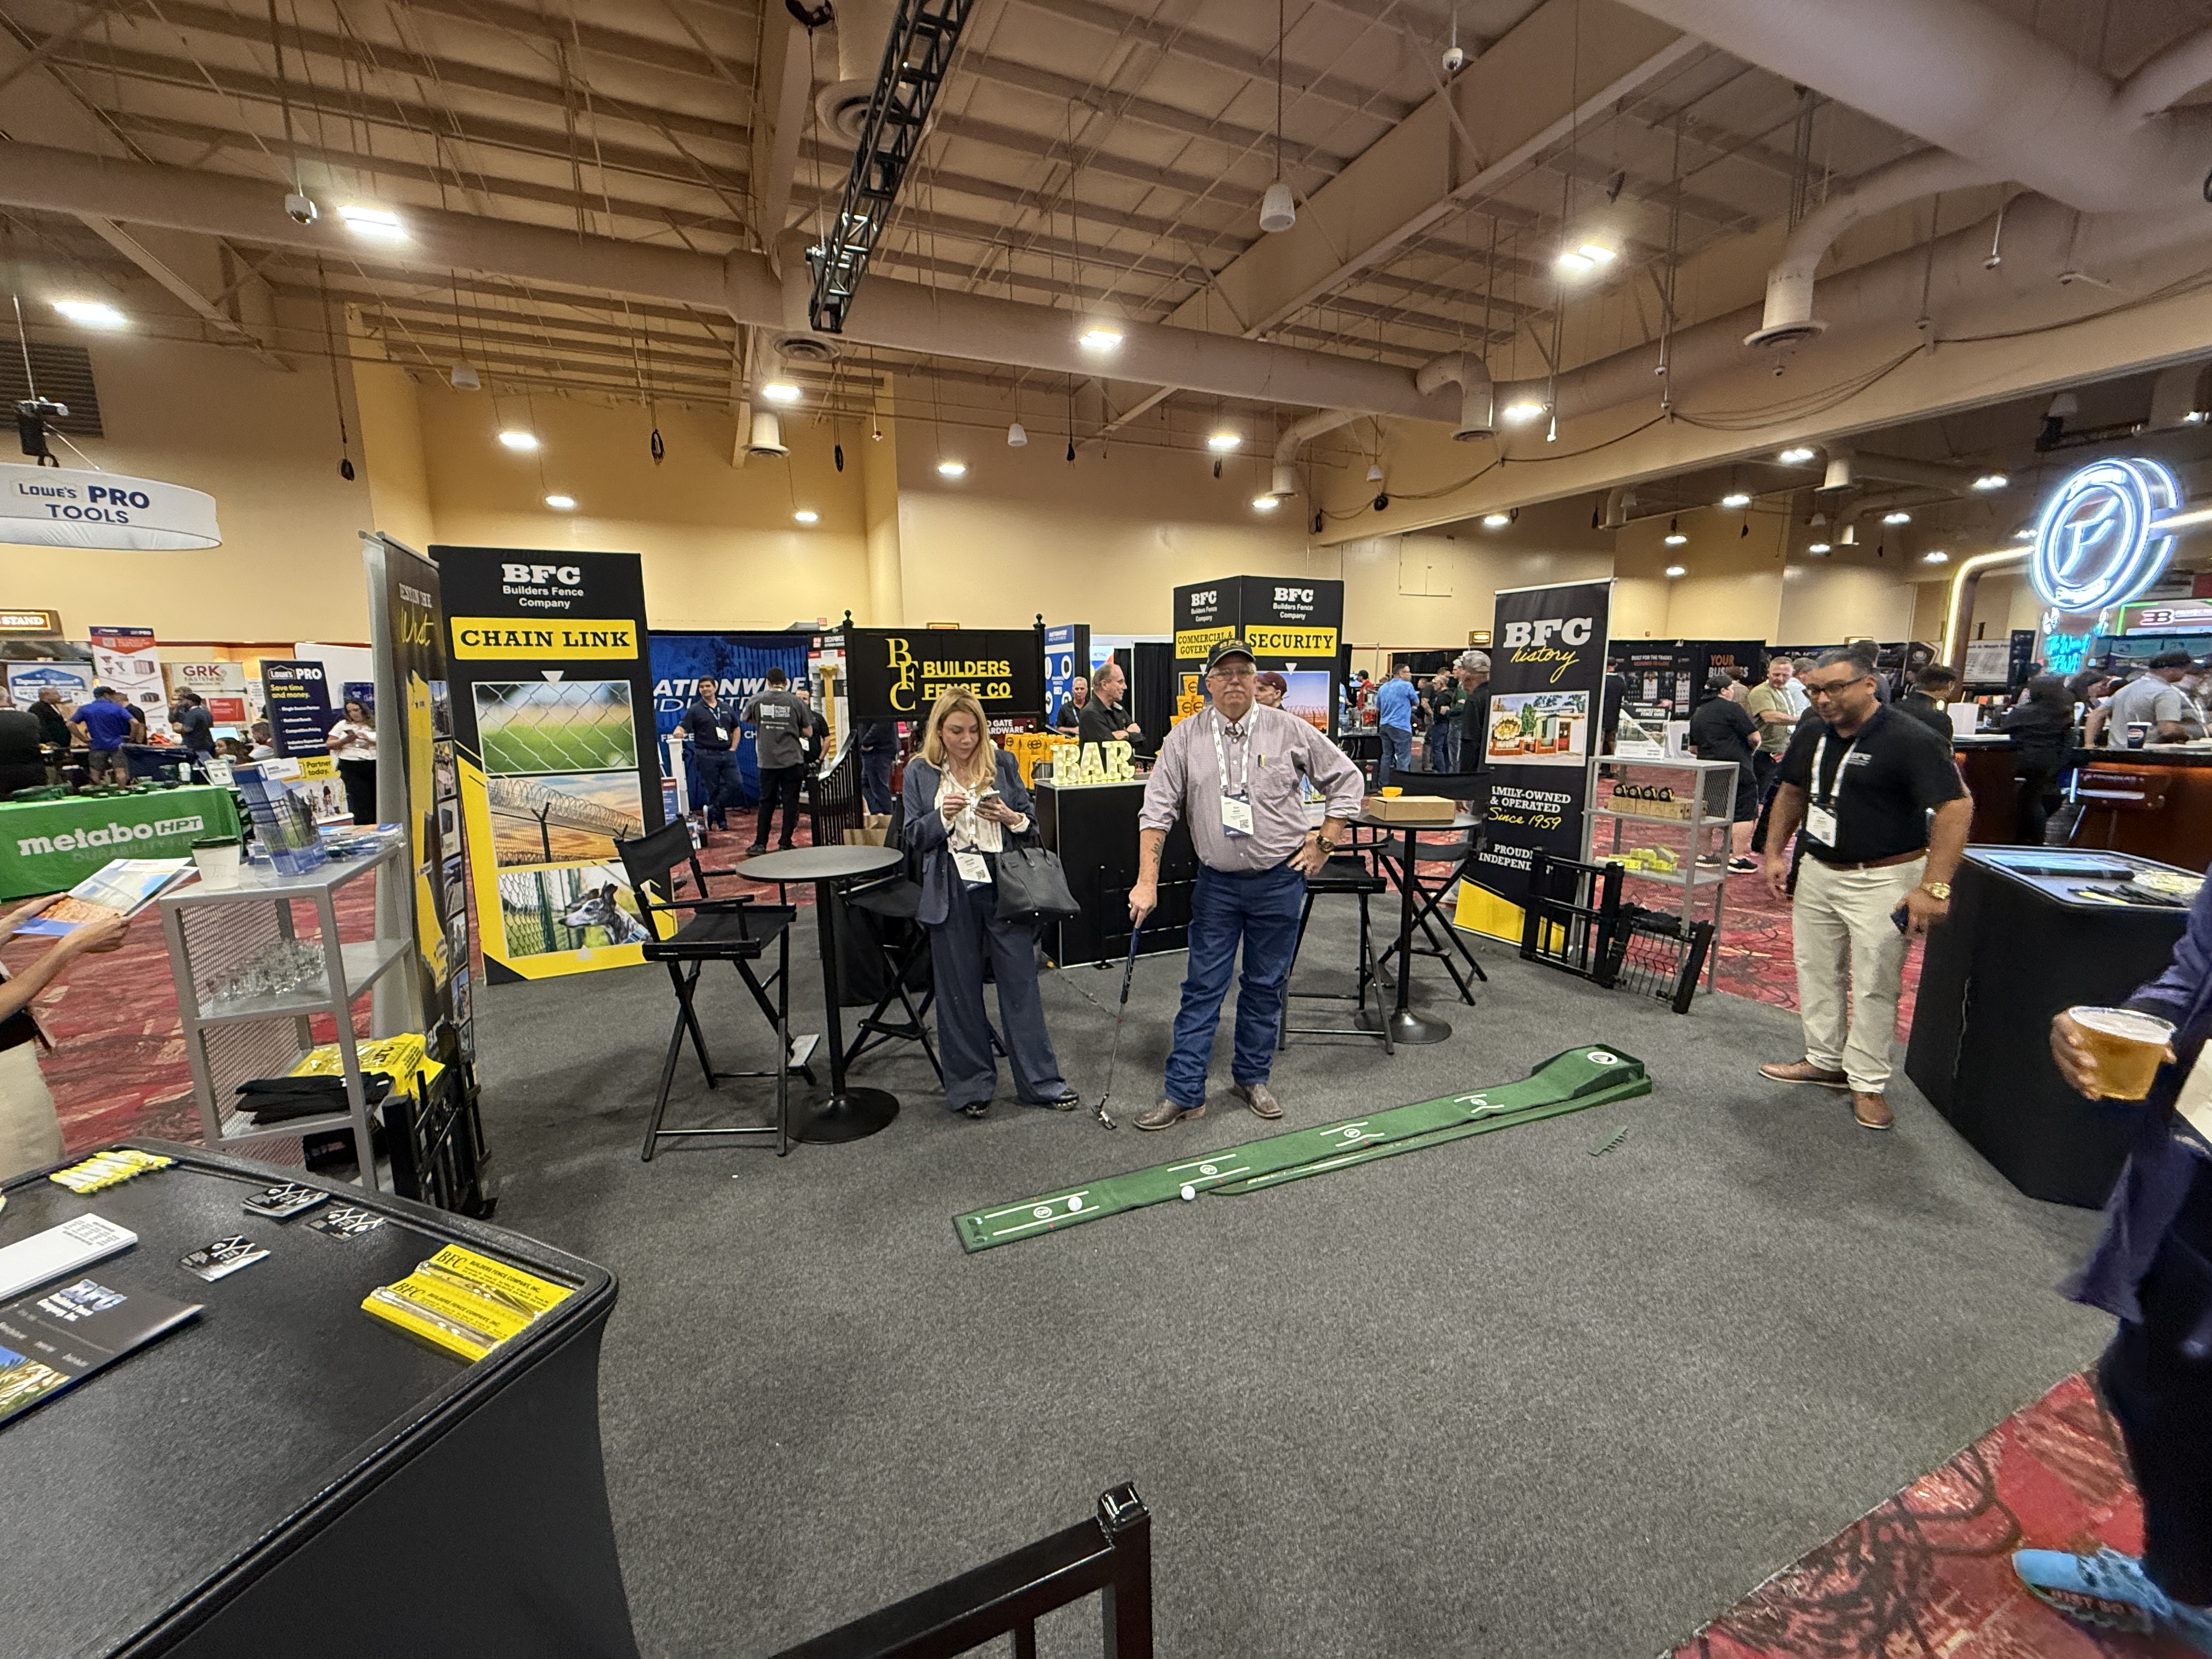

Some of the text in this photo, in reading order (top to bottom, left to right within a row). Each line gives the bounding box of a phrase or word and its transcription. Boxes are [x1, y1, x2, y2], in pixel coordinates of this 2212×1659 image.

[19, 483, 150, 509] LOWE'S PRO
[45, 504, 129, 523] TOOLS
[501, 564, 580, 585] BFC
[503, 585, 584, 596] Builders Fence
[1191, 590, 1217, 607] BFC
[1274, 588, 1313, 602] BFC
[519, 597, 571, 610] Company
[1, 617, 44, 625] STAND
[1280, 611, 1306, 620] Company
[460, 630, 630, 647] CHAIN LINK
[1178, 632, 1224, 645] COMMERCIAL
[1503, 617, 1593, 648] BFC
[1249, 633, 1334, 649] SECURITY
[1510, 644, 1580, 684] history
[1711, 654, 1735, 665] YOUR
[183, 665, 221, 676] GRK
[296, 668, 322, 680] PRO
[923, 661, 1011, 676] BUILDERS
[987, 682, 1011, 697] CO
[987, 726, 1024, 735] ARDWARE
[306, 759, 331, 768] Partner
[1050, 741, 1135, 785] BAR
[1490, 796, 1561, 813] & OPERATED
[1488, 807, 1562, 830] Since 1959
[18, 823, 153, 856] metabo
[160, 818, 200, 833] HPT
[436, 1251, 467, 1268] BFC
[393, 1282, 426, 1298] BFC
